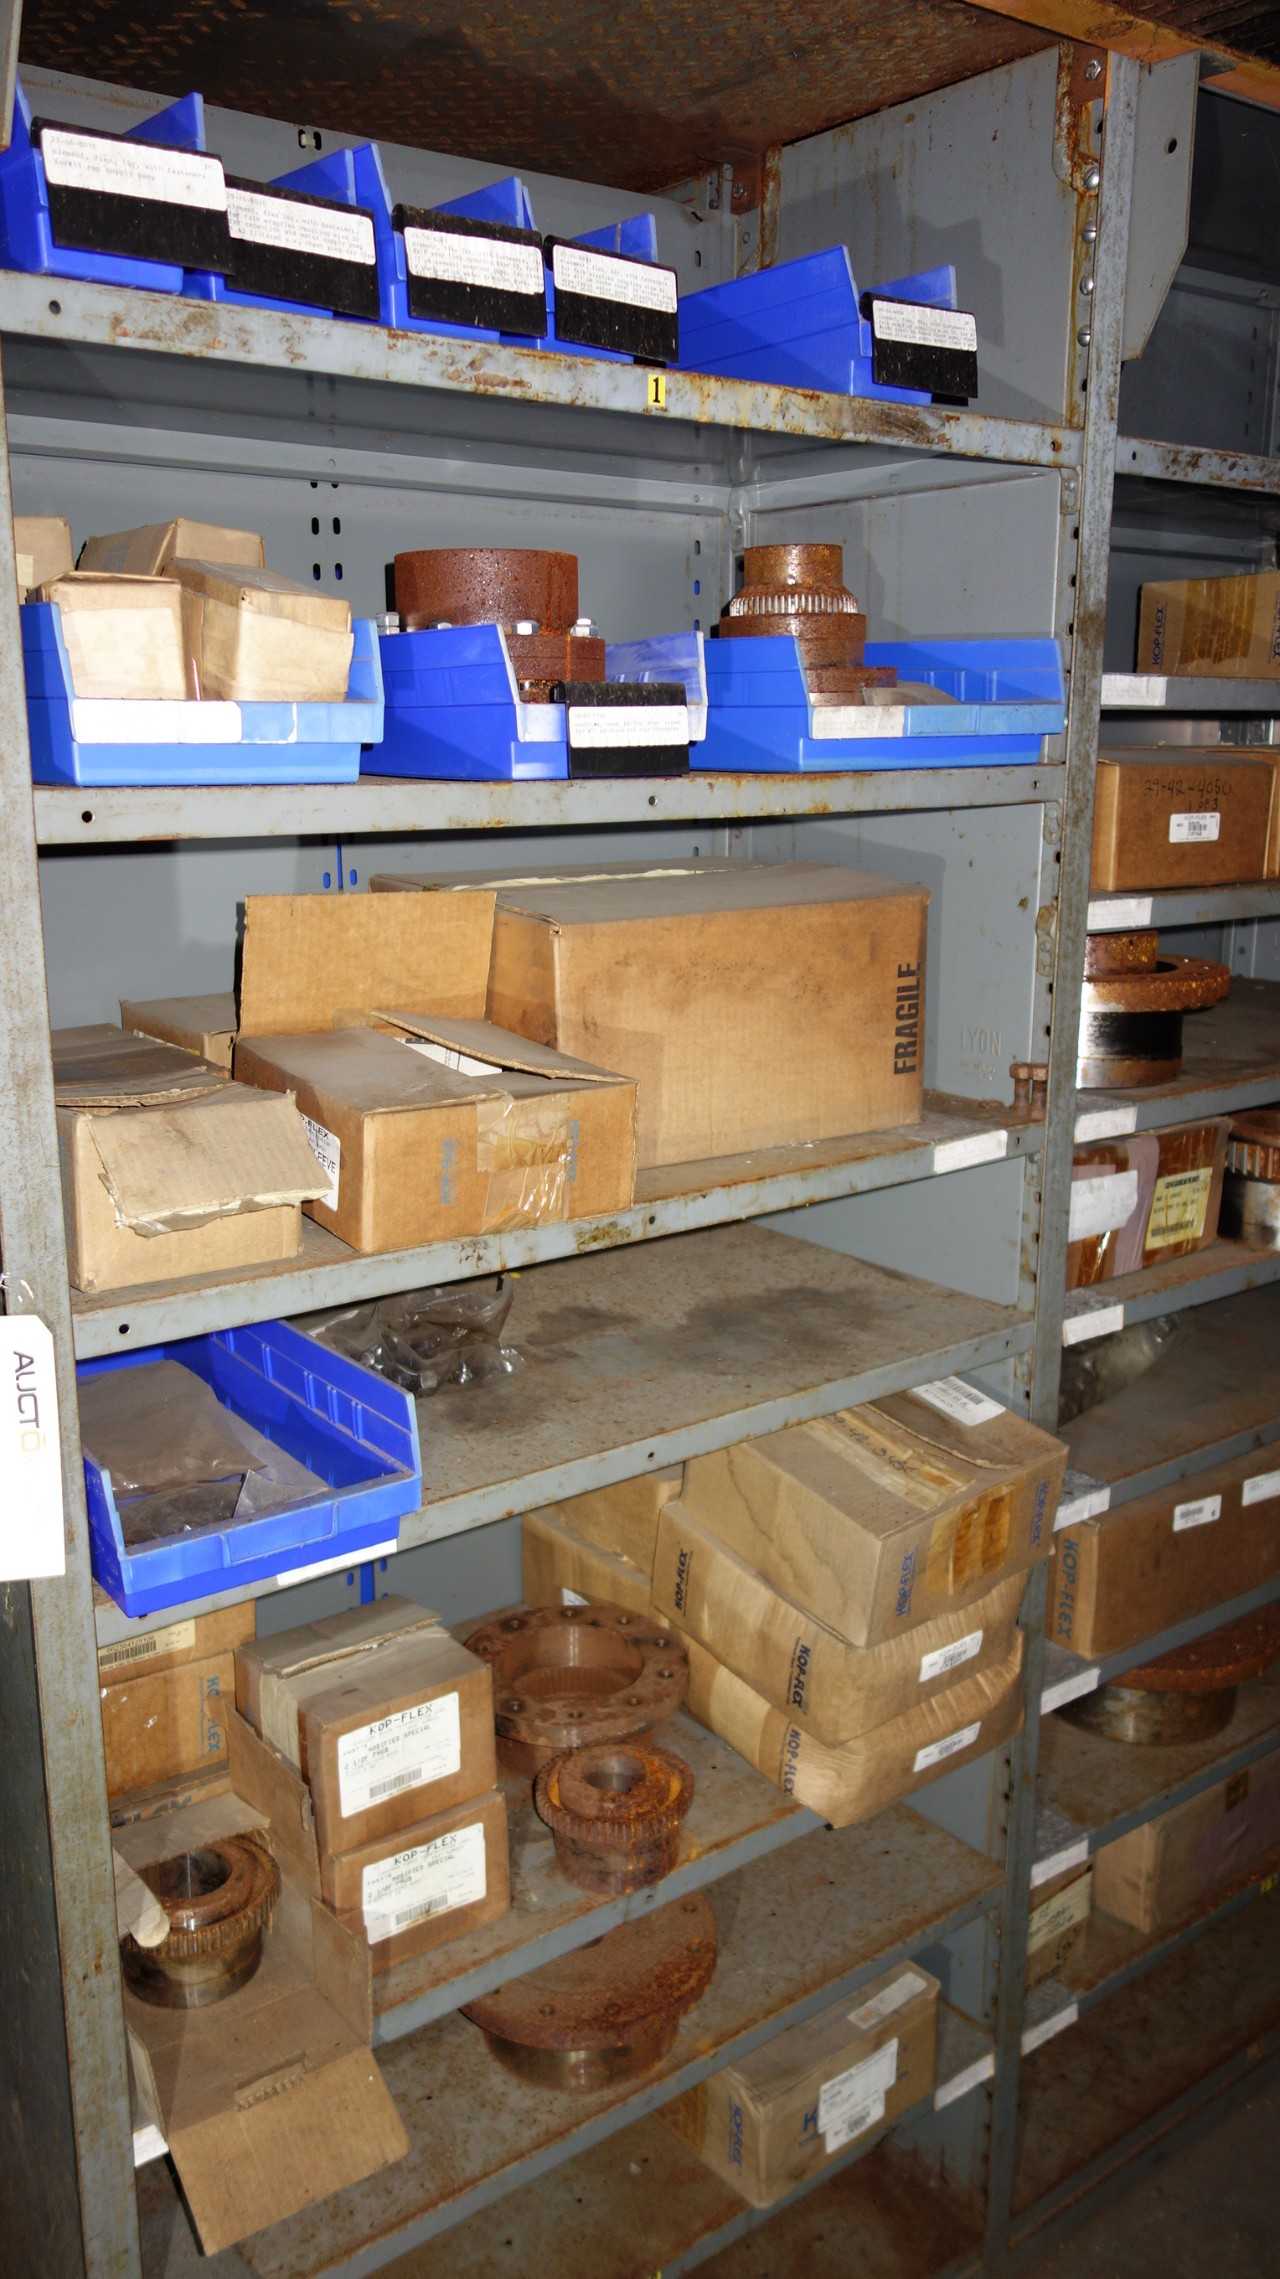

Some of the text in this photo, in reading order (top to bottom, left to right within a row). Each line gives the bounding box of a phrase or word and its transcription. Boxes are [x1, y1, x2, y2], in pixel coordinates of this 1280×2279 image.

[652, 376, 661, 403] 1
[1152, 607, 1165, 665] KOP-FLEX
[894, 960, 921, 1075] FRAGILE
[674, 1548, 689, 1611] KOP-FLEX
[1057, 1539, 1078, 1640] KOP-FLEX
[793, 1643, 811, 1710] KOP-FLEX
[368, 1704, 434, 1736] KOP-FLEX
[784, 1728, 802, 1795] KOP-FLEX
[394, 1834, 458, 1866] KOP-FLEX
